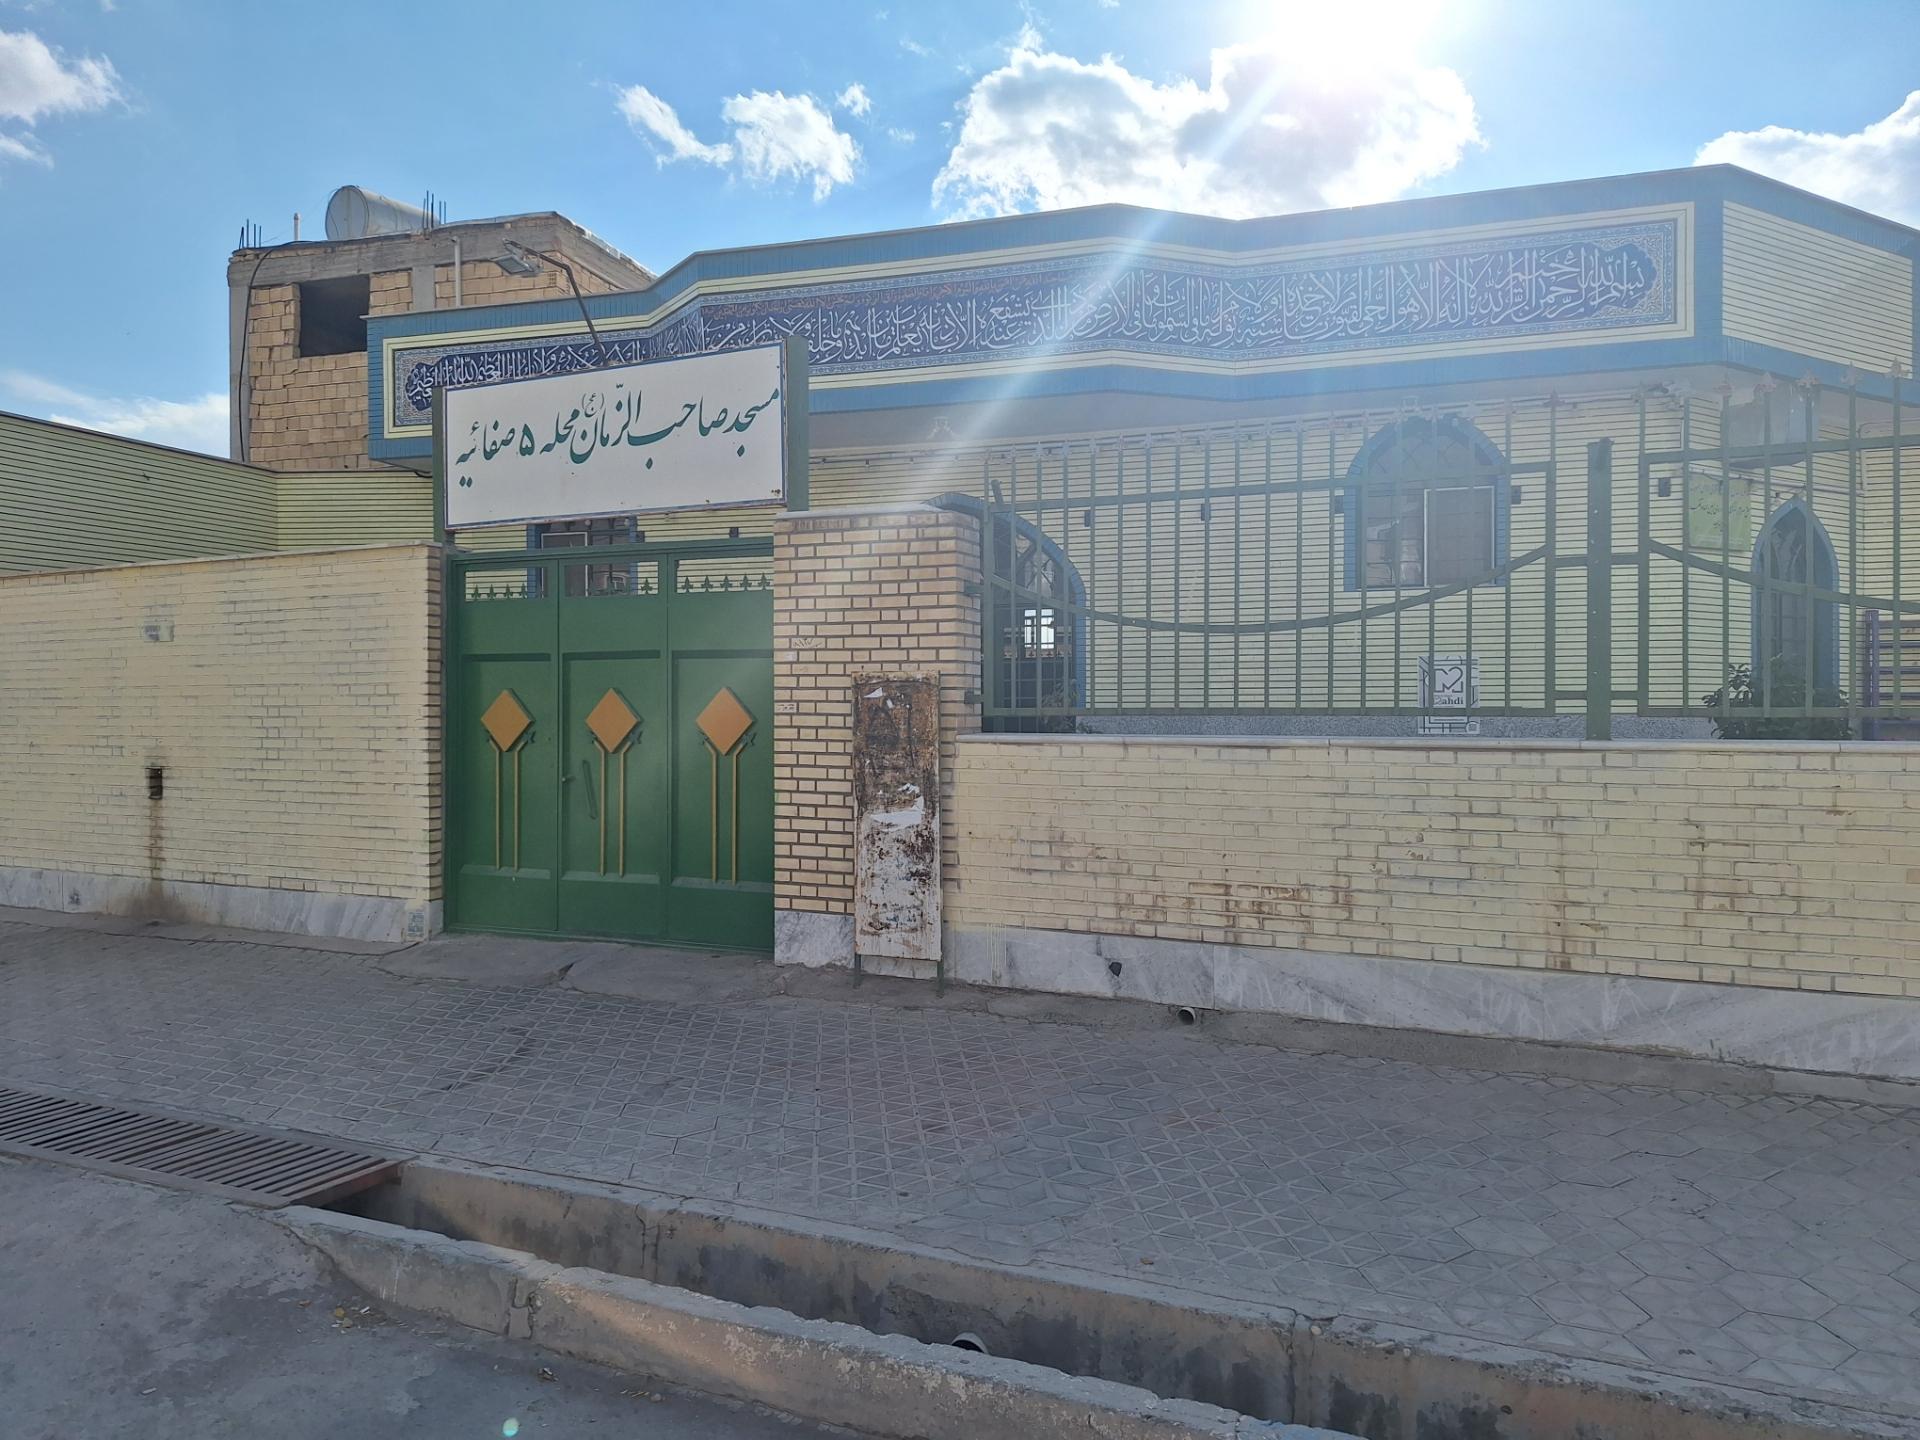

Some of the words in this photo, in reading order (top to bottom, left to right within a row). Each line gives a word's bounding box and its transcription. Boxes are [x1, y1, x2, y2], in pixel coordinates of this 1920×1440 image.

[539, 408, 580, 454] محله
[627, 398, 728, 470] صاحب
[722, 388, 779, 457] مسجد
